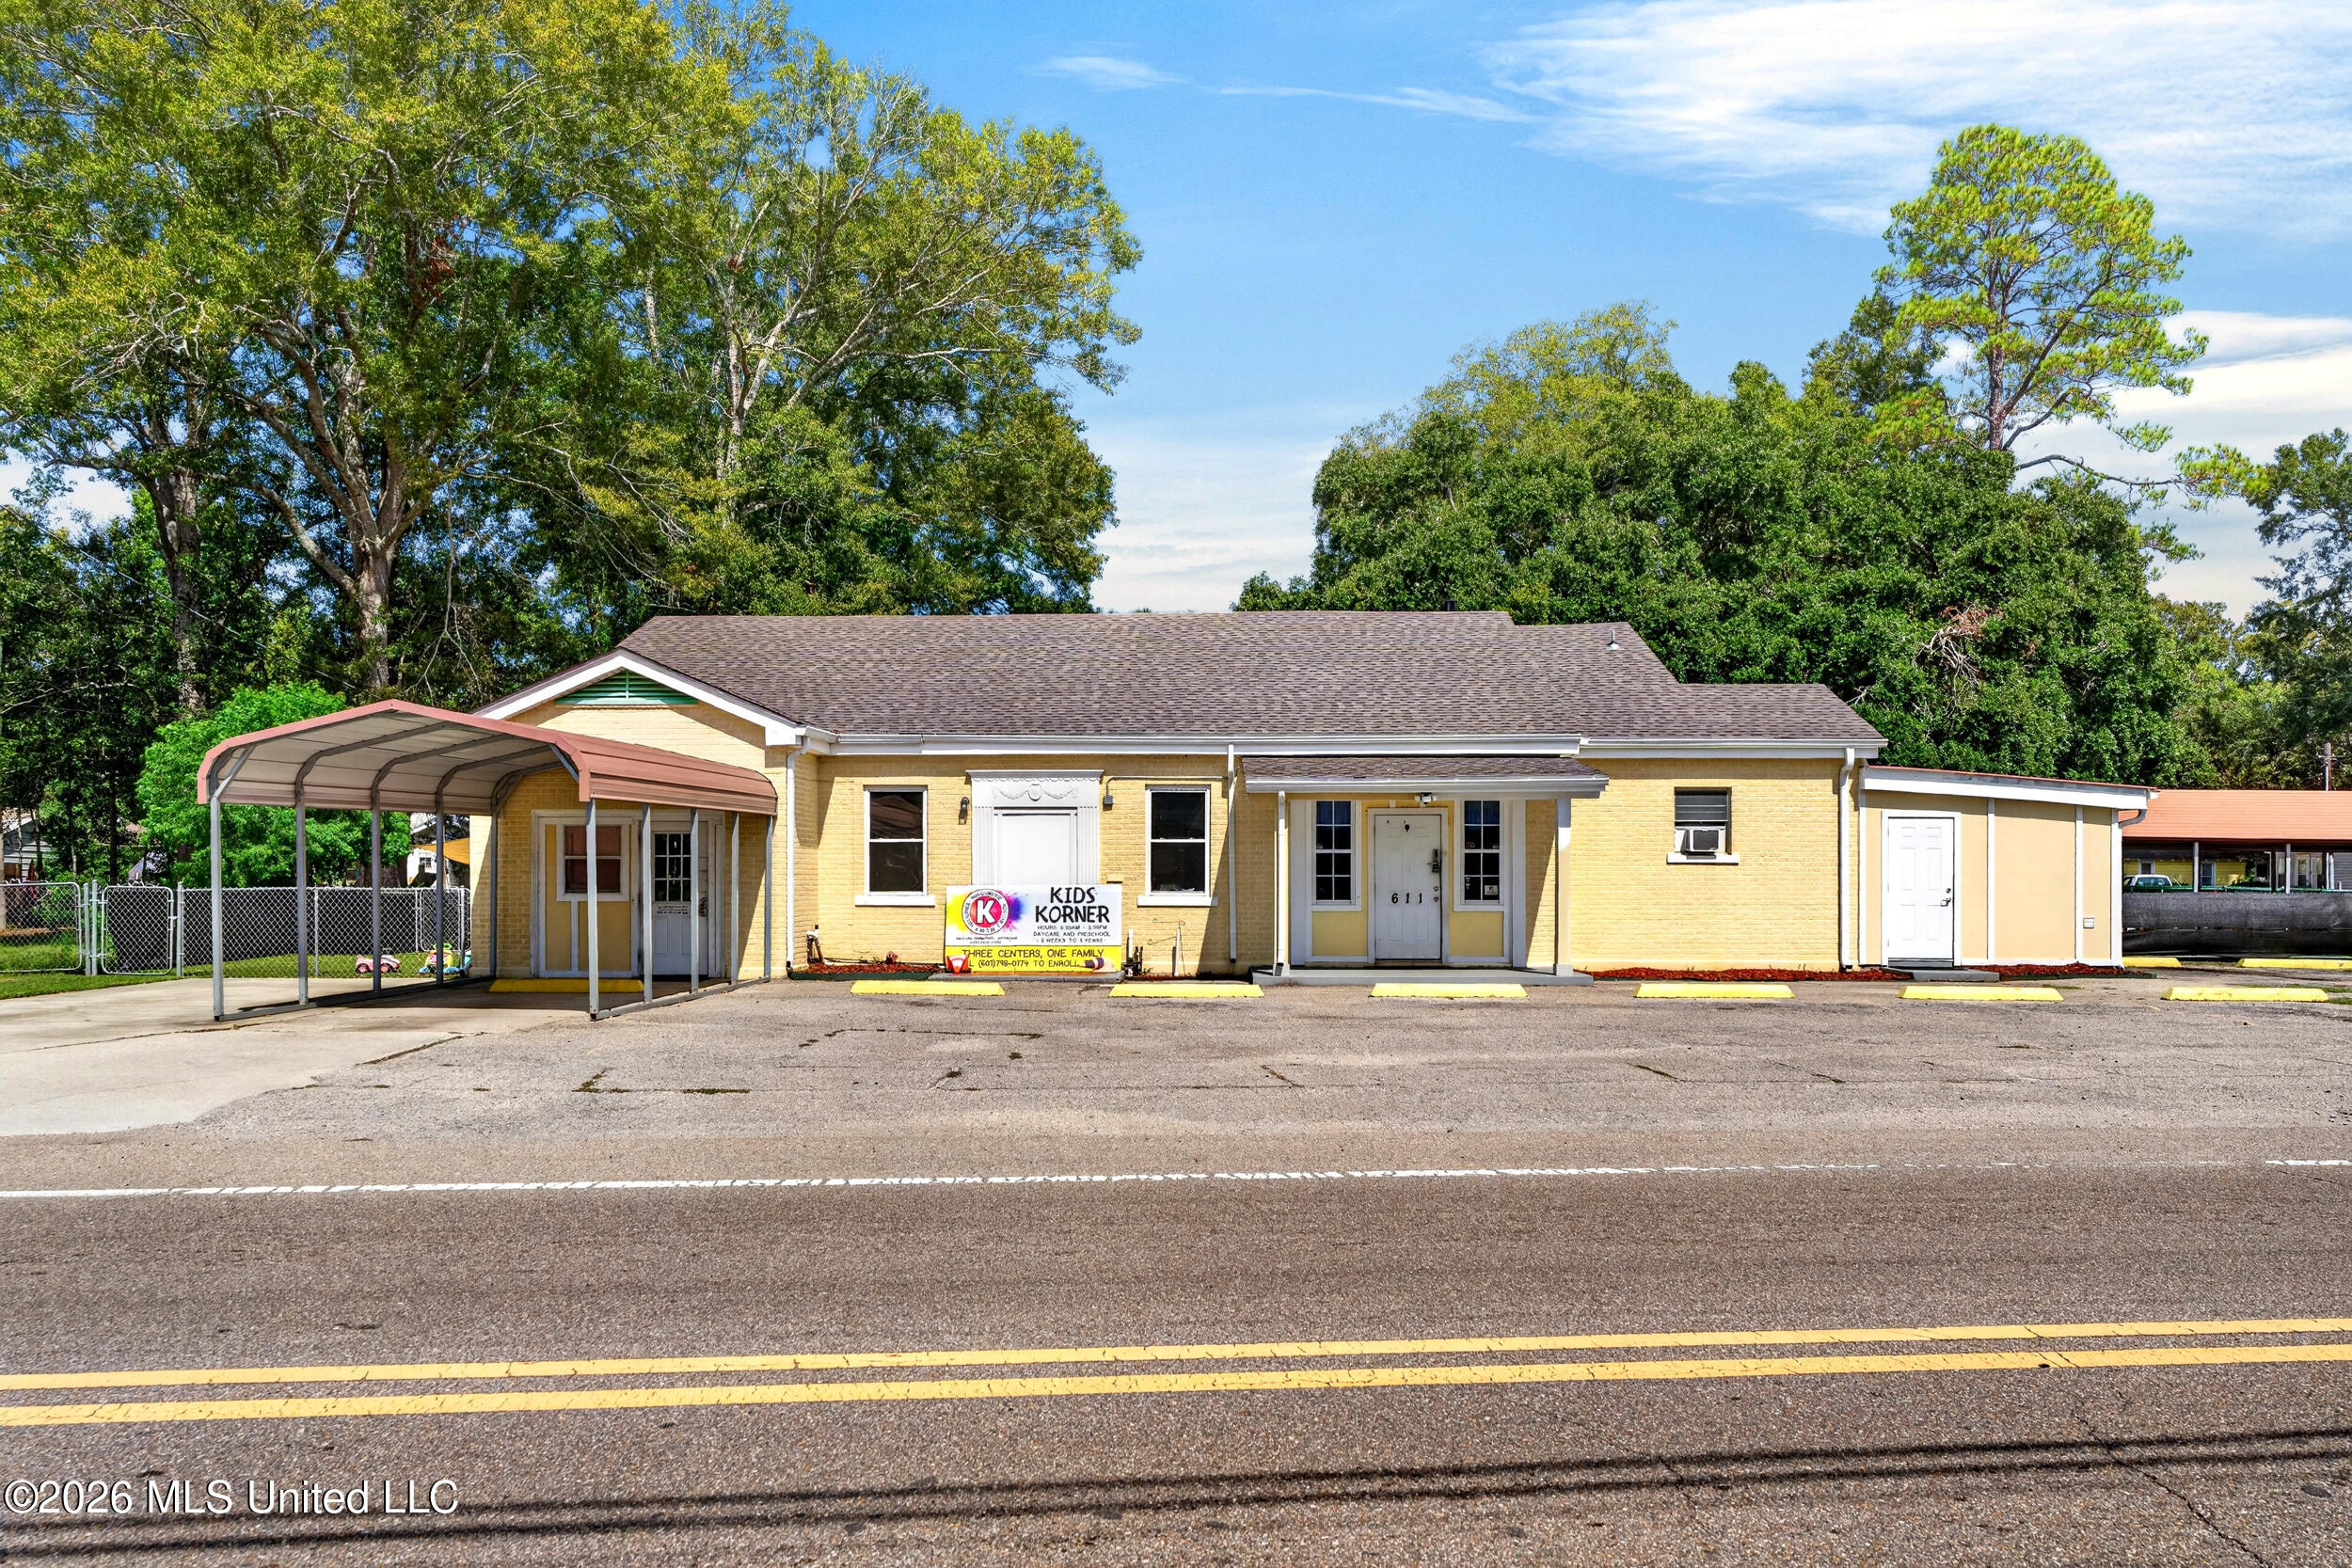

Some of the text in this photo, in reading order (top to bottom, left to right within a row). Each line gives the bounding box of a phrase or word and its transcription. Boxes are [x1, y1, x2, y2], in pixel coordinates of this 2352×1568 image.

[1050, 887, 1096, 903] KIDS
[1391, 893, 1422, 904] 611
[976, 899, 996, 924] K
[1035, 905, 1110, 923] KORNER
[961, 949, 1104, 958] THREE CENTERS, ONE FAMILY
